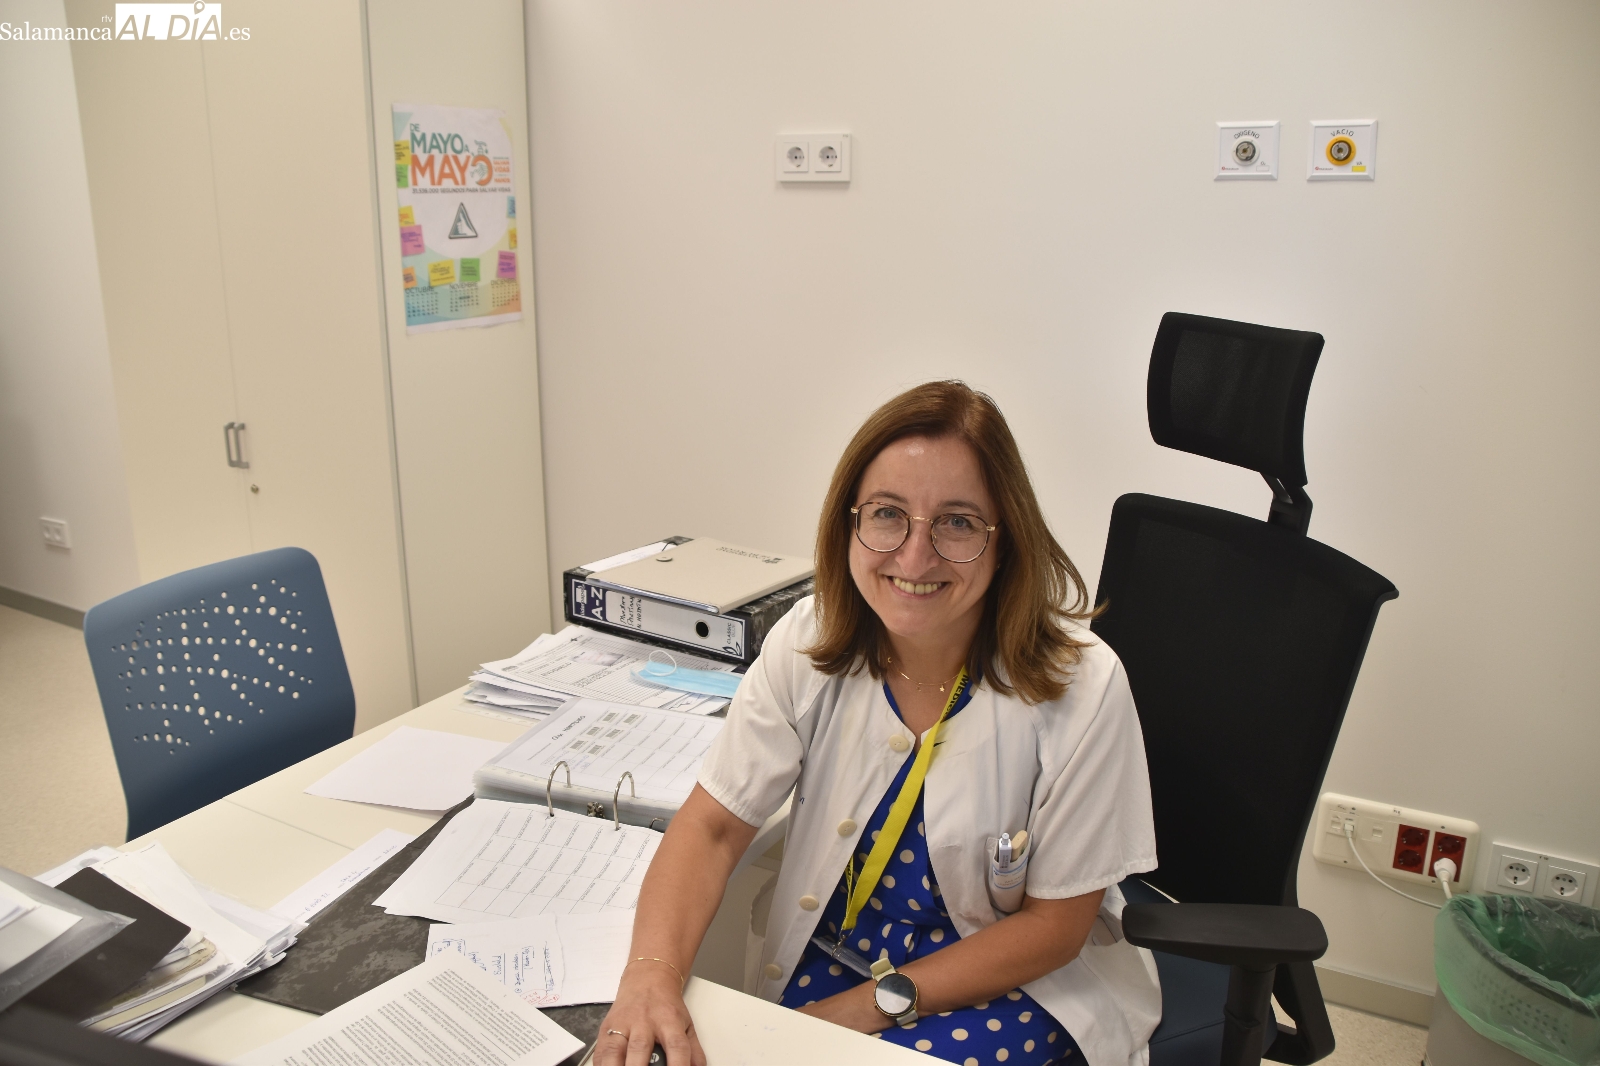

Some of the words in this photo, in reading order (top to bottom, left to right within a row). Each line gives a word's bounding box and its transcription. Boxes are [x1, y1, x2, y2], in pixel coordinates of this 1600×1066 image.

[410, 123, 420, 132] DE
[410, 132, 464, 154] MAYO
[405, 286, 435, 294] OCTUBRE
[591, 586, 603, 620] A-Z
